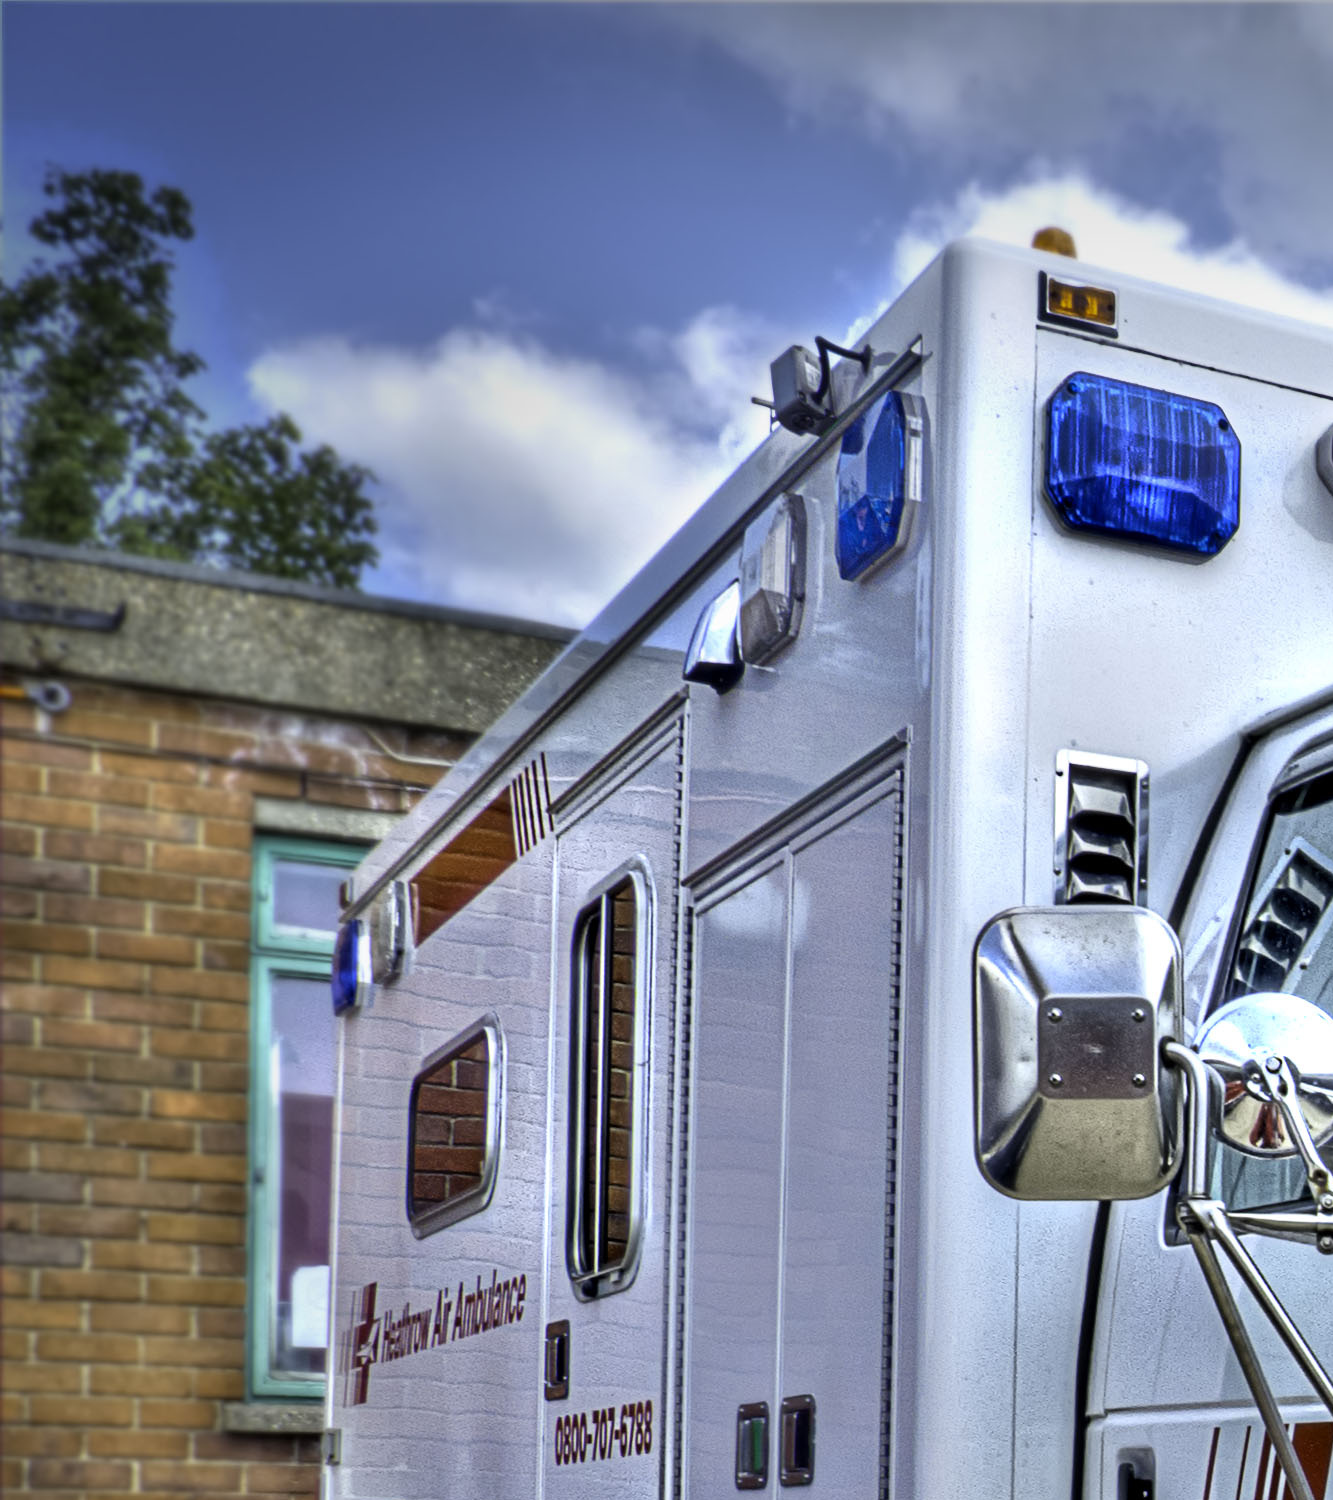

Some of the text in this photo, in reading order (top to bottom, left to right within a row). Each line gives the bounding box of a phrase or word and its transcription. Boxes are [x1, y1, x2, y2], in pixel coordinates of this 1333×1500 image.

[431, 1287, 453, 1348] Air
[451, 1269, 527, 1341] Ambulance
[554, 1399, 653, 1466] 0800-707-6788
